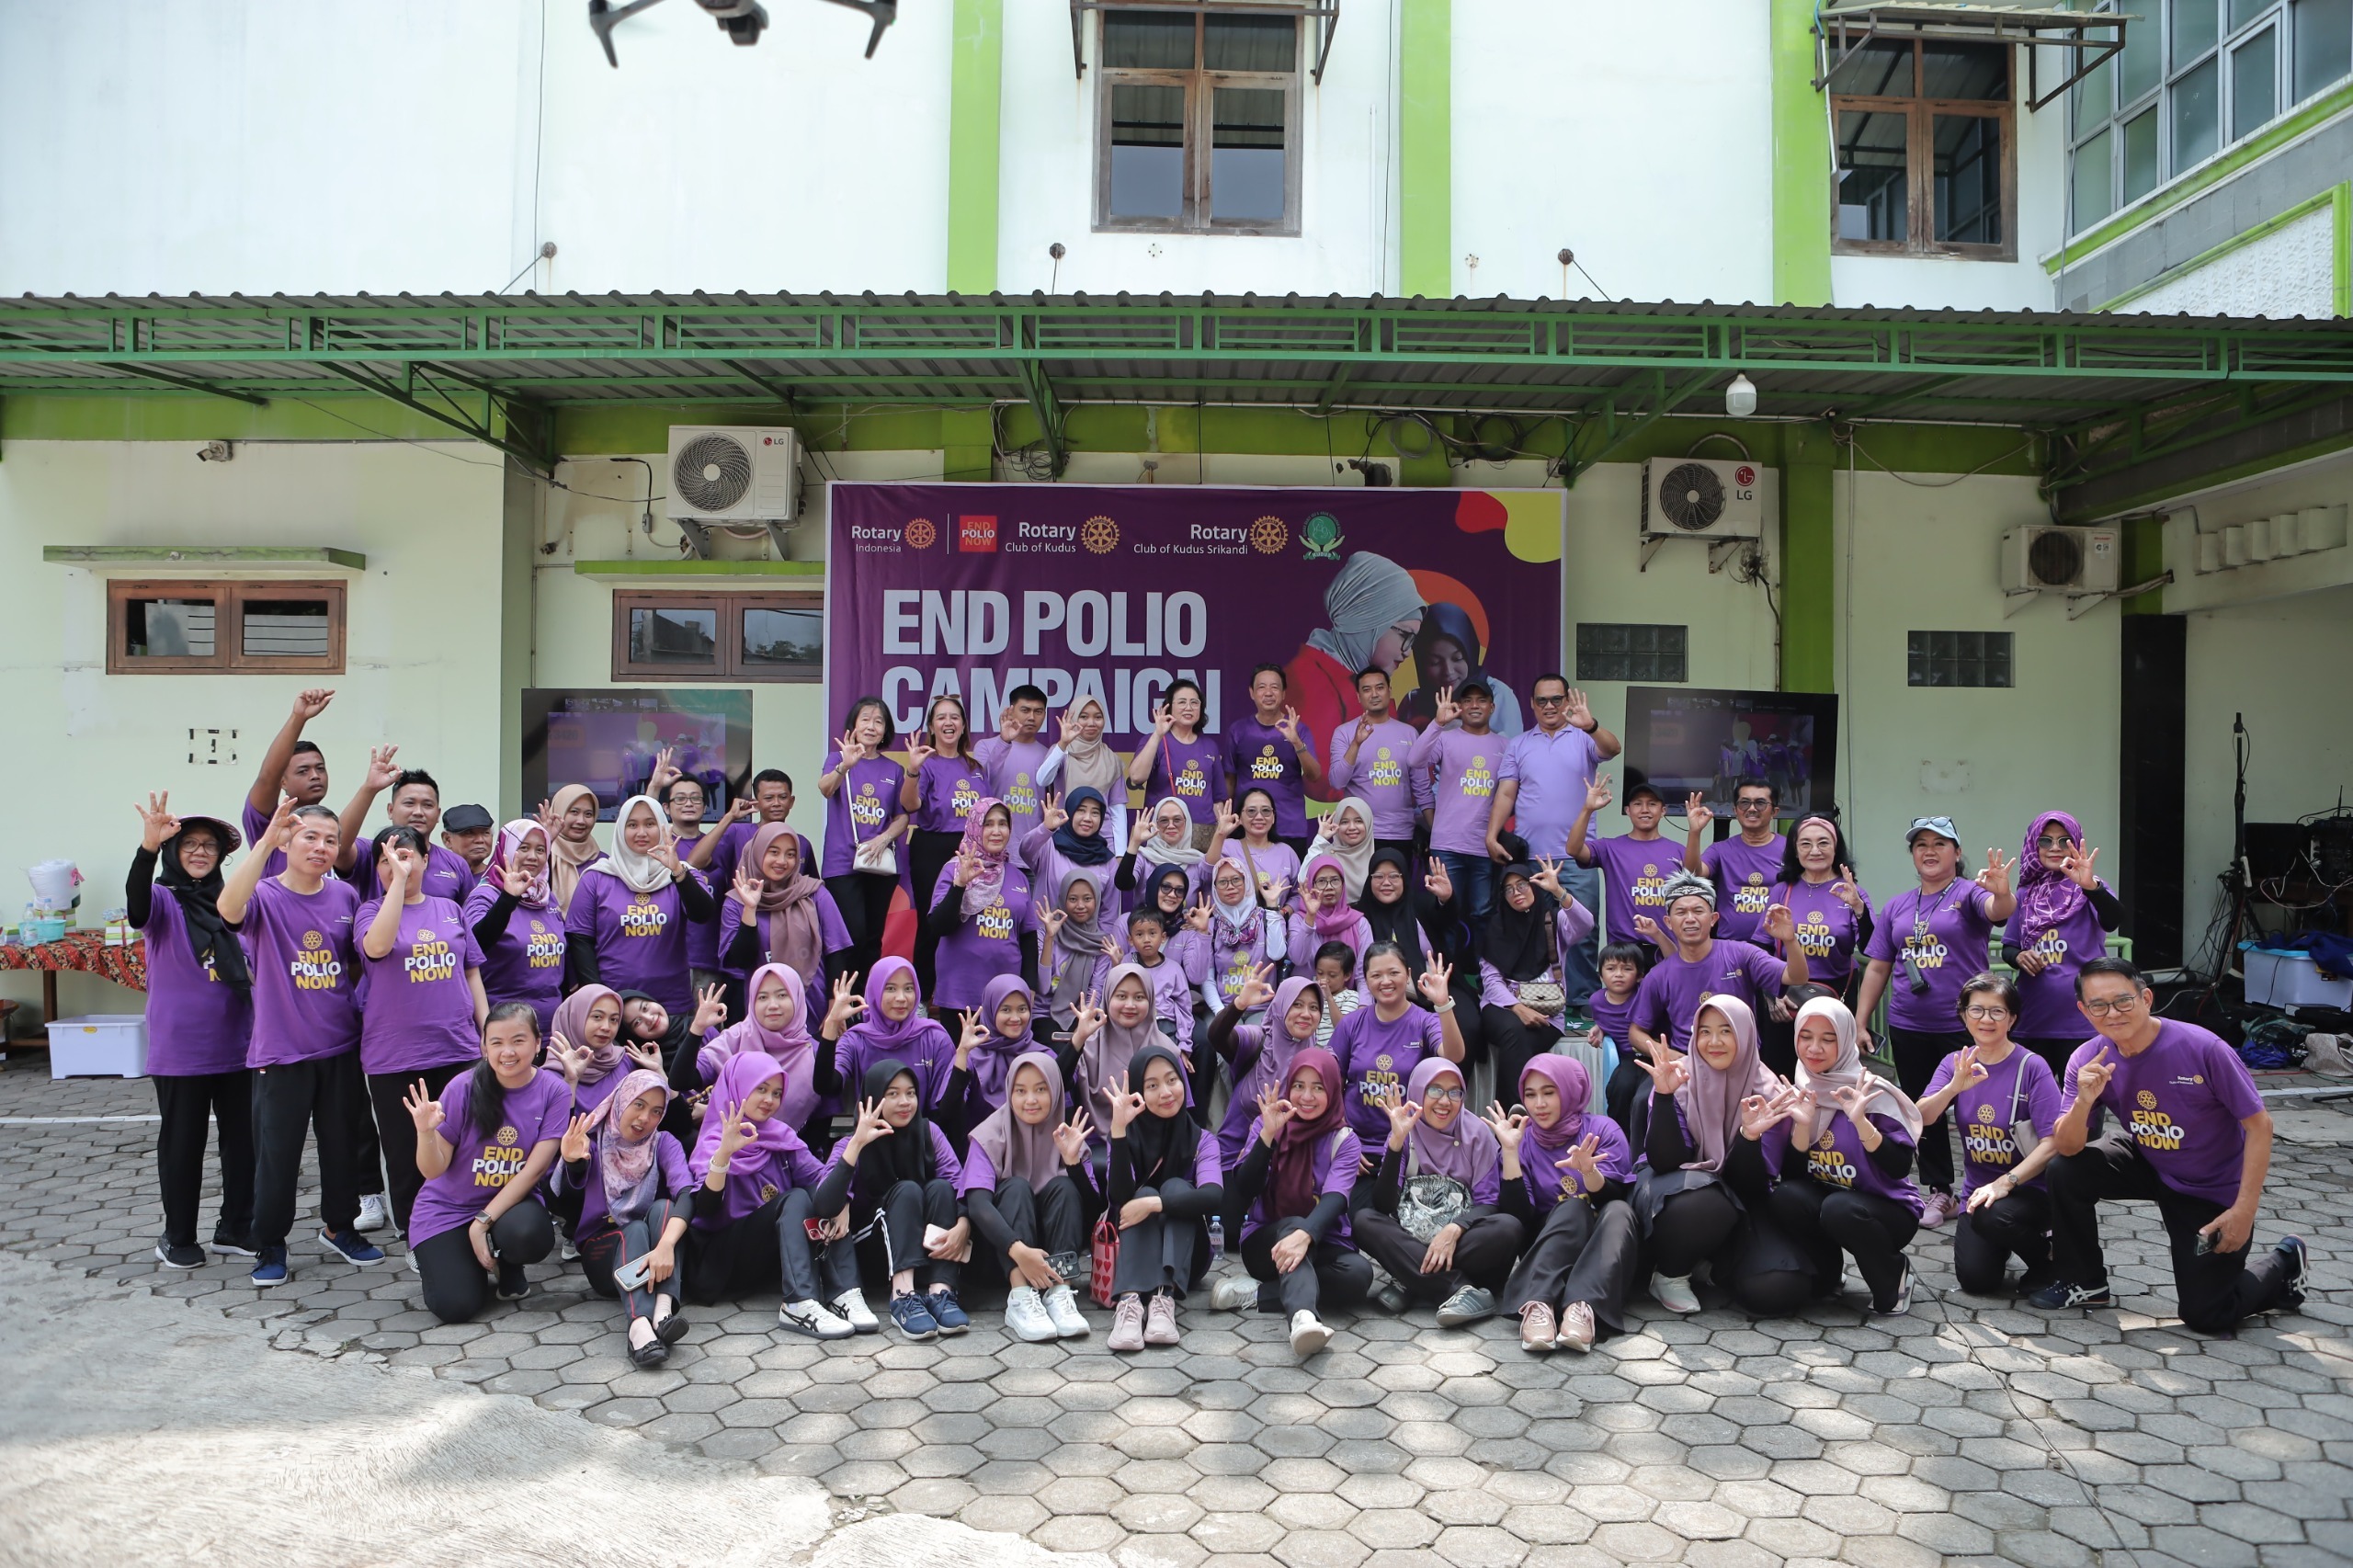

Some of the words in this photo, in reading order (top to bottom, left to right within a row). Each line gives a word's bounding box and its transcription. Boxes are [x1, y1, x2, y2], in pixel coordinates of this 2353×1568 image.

[1736, 490, 1753, 501] LG
[967, 521, 991, 530] END
[1018, 522, 1076, 540] Rotary
[851, 525, 902, 541] Rotary
[961, 529, 995, 539] POLIO
[1190, 524, 1248, 543] Rotary
[856, 543, 902, 552] Indonesia
[965, 538, 992, 546] NOW
[1005, 542, 1029, 552] Club
[1031, 542, 1043, 552] of
[1045, 542, 1076, 552] Kudus
[1133, 544, 1156, 553] Club
[1159, 543, 1171, 553] of
[1173, 544, 1204, 554] Kudus
[1207, 544, 1248, 555] Srikandi
[882, 589, 1009, 655] END
[1023, 589, 1208, 658] POLIO
[881, 665, 1221, 734] CAMPAIGN
[1251, 763, 1283, 773] POLIO
[1256, 756, 1279, 767] END
[1373, 760, 1397, 770] END
[1182, 769, 1203, 779] END
[1253, 770, 1280, 779] NOW
[1368, 767, 1402, 779] POLIO
[1466, 768, 1490, 780] END
[1176, 777, 1207, 790] POLIO
[1373, 777, 1399, 786] NOW
[1460, 777, 1495, 790] POLIO
[954, 790, 980, 800] END
[1010, 786, 1033, 797] END
[1177, 786, 1203, 797] NOW
[1463, 786, 1491, 797] NOW
[856, 794, 880, 808] END
[951, 798, 977, 809] POL
[1003, 794, 1037, 808] POLIO
[852, 802, 885, 818] POLIO
[1010, 804, 1034, 815] NOW
[854, 812, 881, 825] NOW
[1637, 878, 1665, 888] END
[1741, 886, 1768, 896] END
[1635, 896, 1665, 906] NOW
[627, 904, 659, 916] END
[983, 905, 1010, 918] END
[620, 913, 667, 926] POLIO
[976, 915, 1014, 930] POLIO
[625, 924, 663, 937] NOW
[978, 925, 1009, 940] NOW
[1797, 923, 1829, 936] END
[529, 933, 559, 945] END
[412, 941, 449, 958] END
[527, 941, 565, 957] POLIO
[1901, 943, 1948, 960] POLIO
[2031, 939, 2068, 956] OLIO
[297, 949, 333, 965] END
[404, 951, 457, 971] POLIO
[529, 952, 561, 968] NOW
[2040, 952, 2063, 965] OW
[290, 960, 342, 977] POLIO
[410, 966, 452, 983] NOW
[295, 974, 336, 990] NOW
[1222, 974, 1245, 985] POL
[1224, 983, 1244, 995] NO
[1366, 1070, 1399, 1085] END
[1363, 1093, 1386, 1108] NO
[2131, 1110, 2171, 1127] END
[1968, 1123, 2005, 1141] END
[2130, 1121, 2185, 1140] POLIO
[1965, 1136, 2015, 1153] POLIO
[2136, 1133, 2180, 1151] NOW
[483, 1145, 524, 1162] END
[1809, 1150, 1845, 1166] END
[1970, 1150, 2012, 1165] NOW
[1807, 1159, 1857, 1179] POLIO
